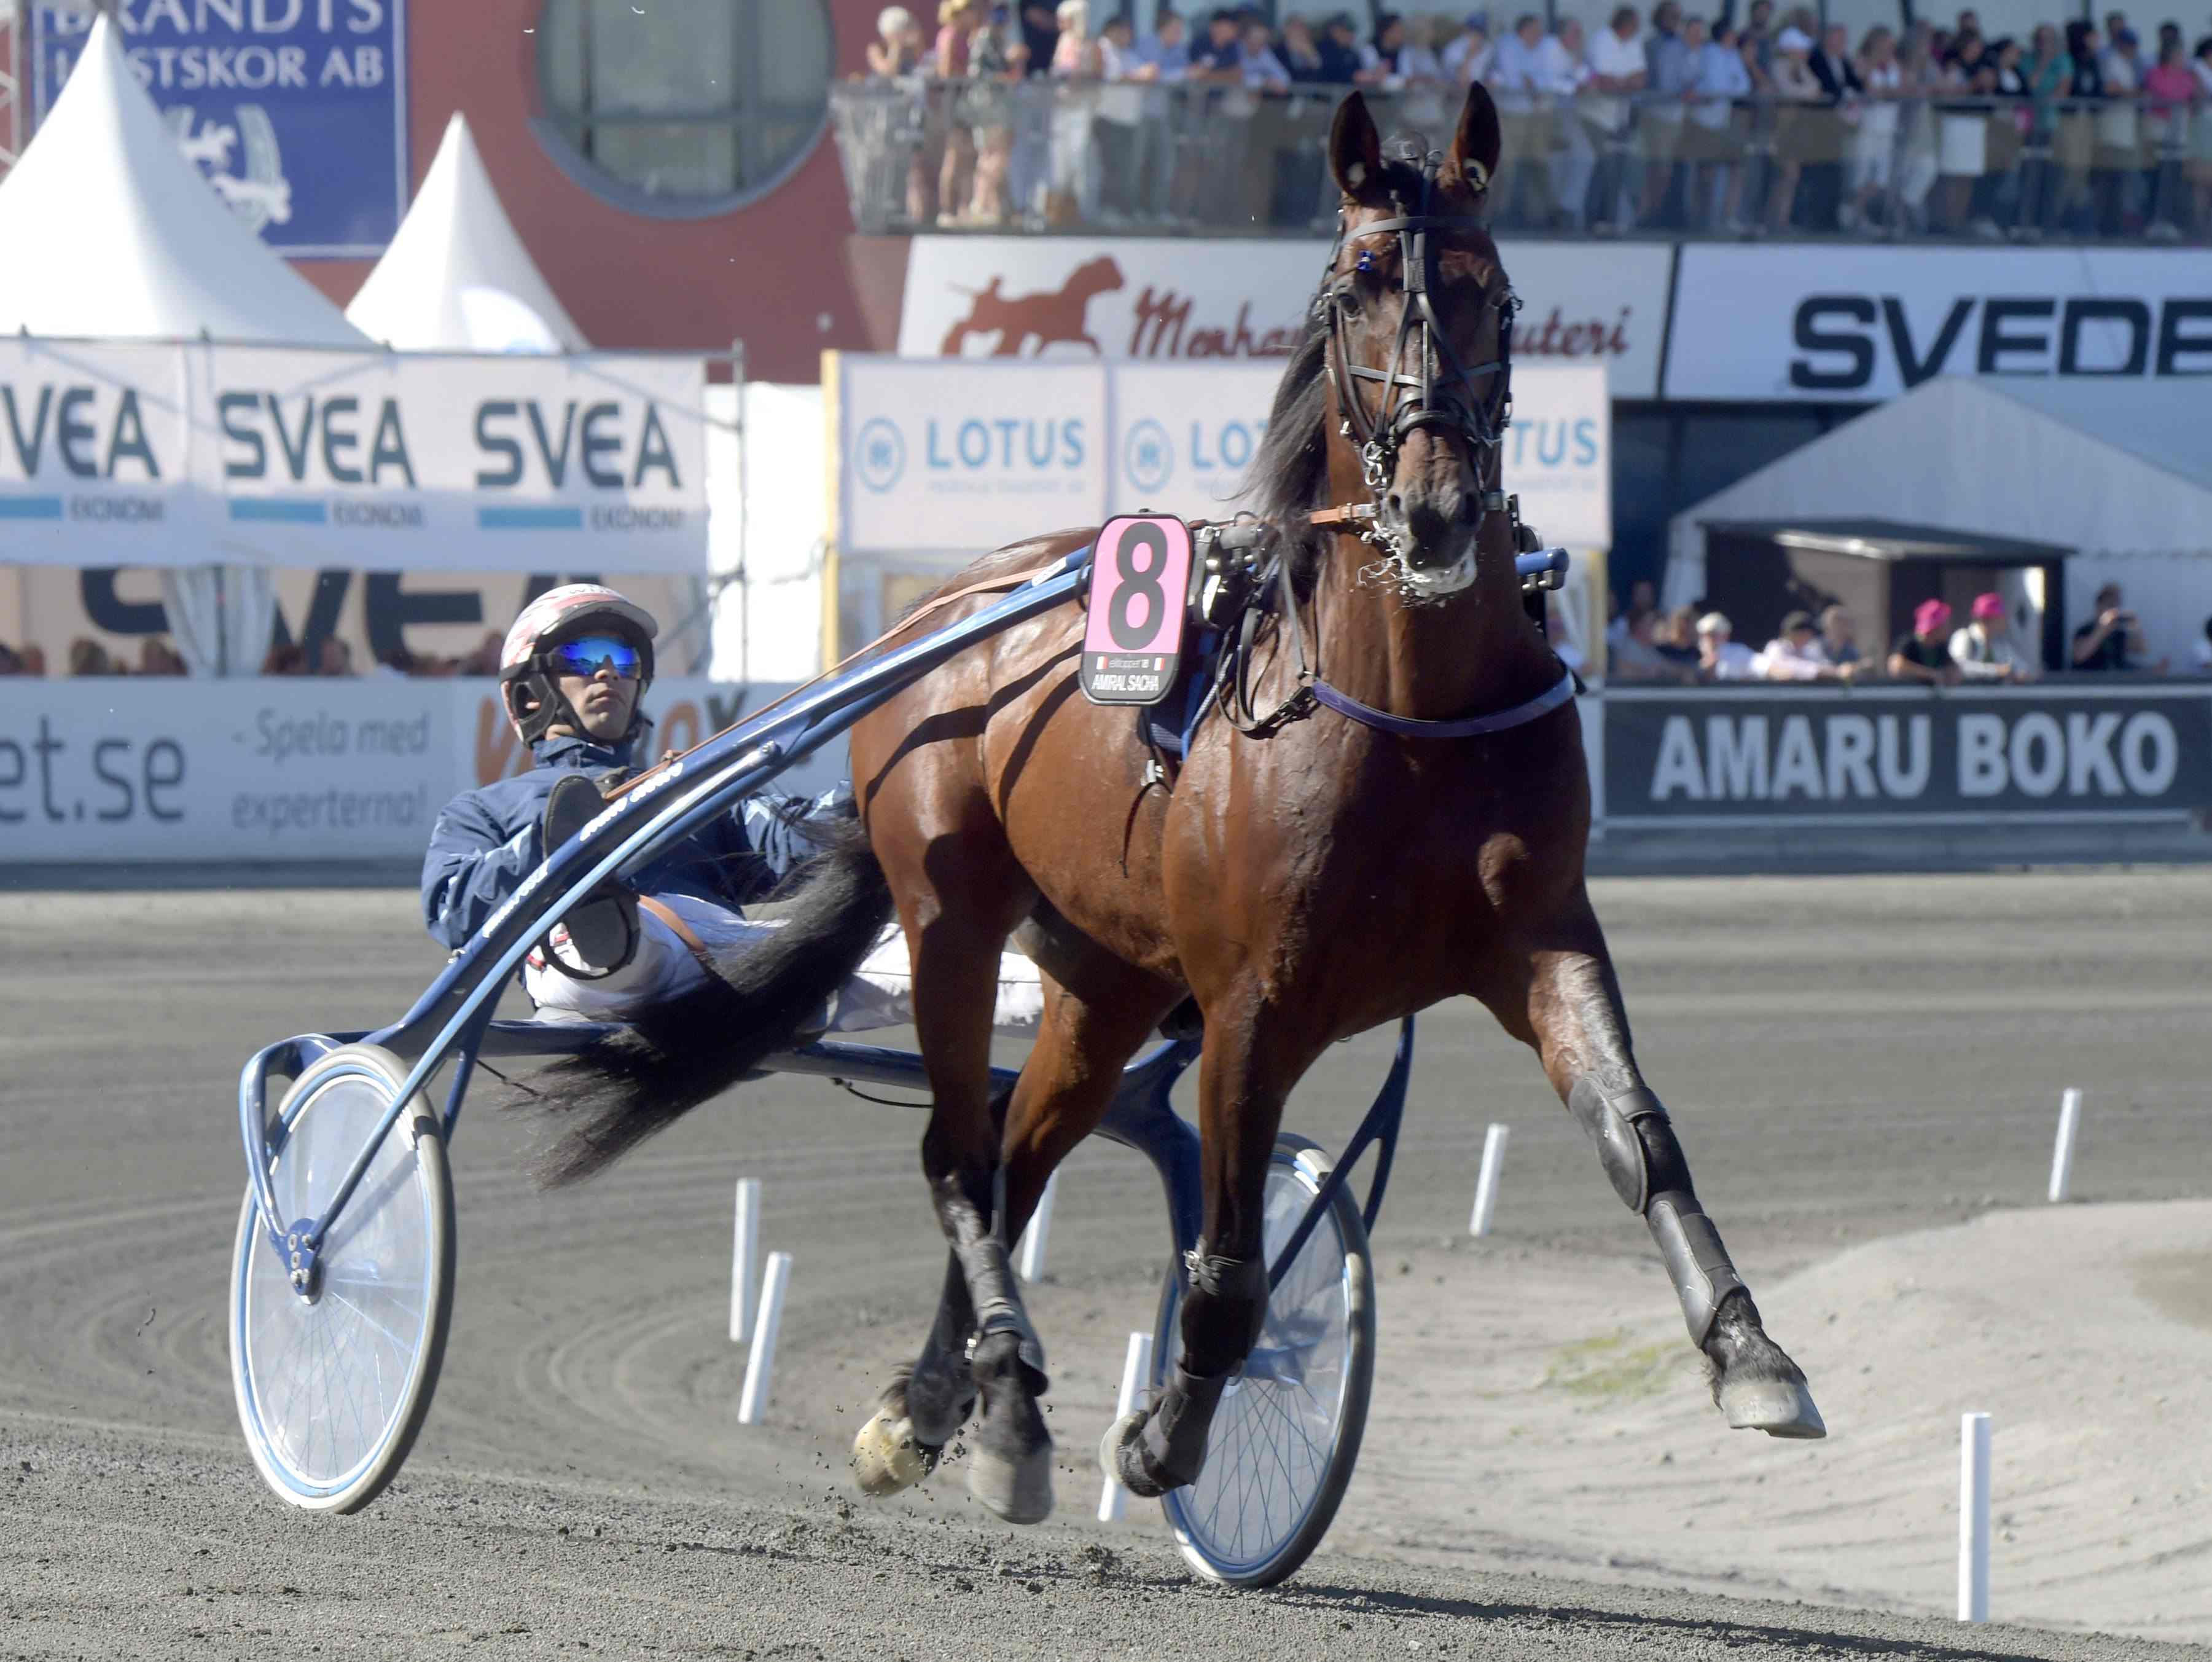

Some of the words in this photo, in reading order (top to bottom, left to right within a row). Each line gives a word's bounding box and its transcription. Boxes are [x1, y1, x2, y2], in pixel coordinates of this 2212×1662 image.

[319, 45, 385, 88] AB
[1509, 305, 1632, 358] uteri
[1789, 293, 2212, 391] SVEDE
[217, 390, 418, 489] SVEA
[474, 399, 682, 489] SVEA
[925, 417, 1086, 471] LOTUS
[1507, 418, 1598, 468] TUS
[1108, 521, 1168, 651] 8
[0, 713, 187, 825] et.se
[355, 707, 429, 756] med
[1649, 714, 1932, 801] AMARU
[1958, 711, 2178, 799] BOKO
